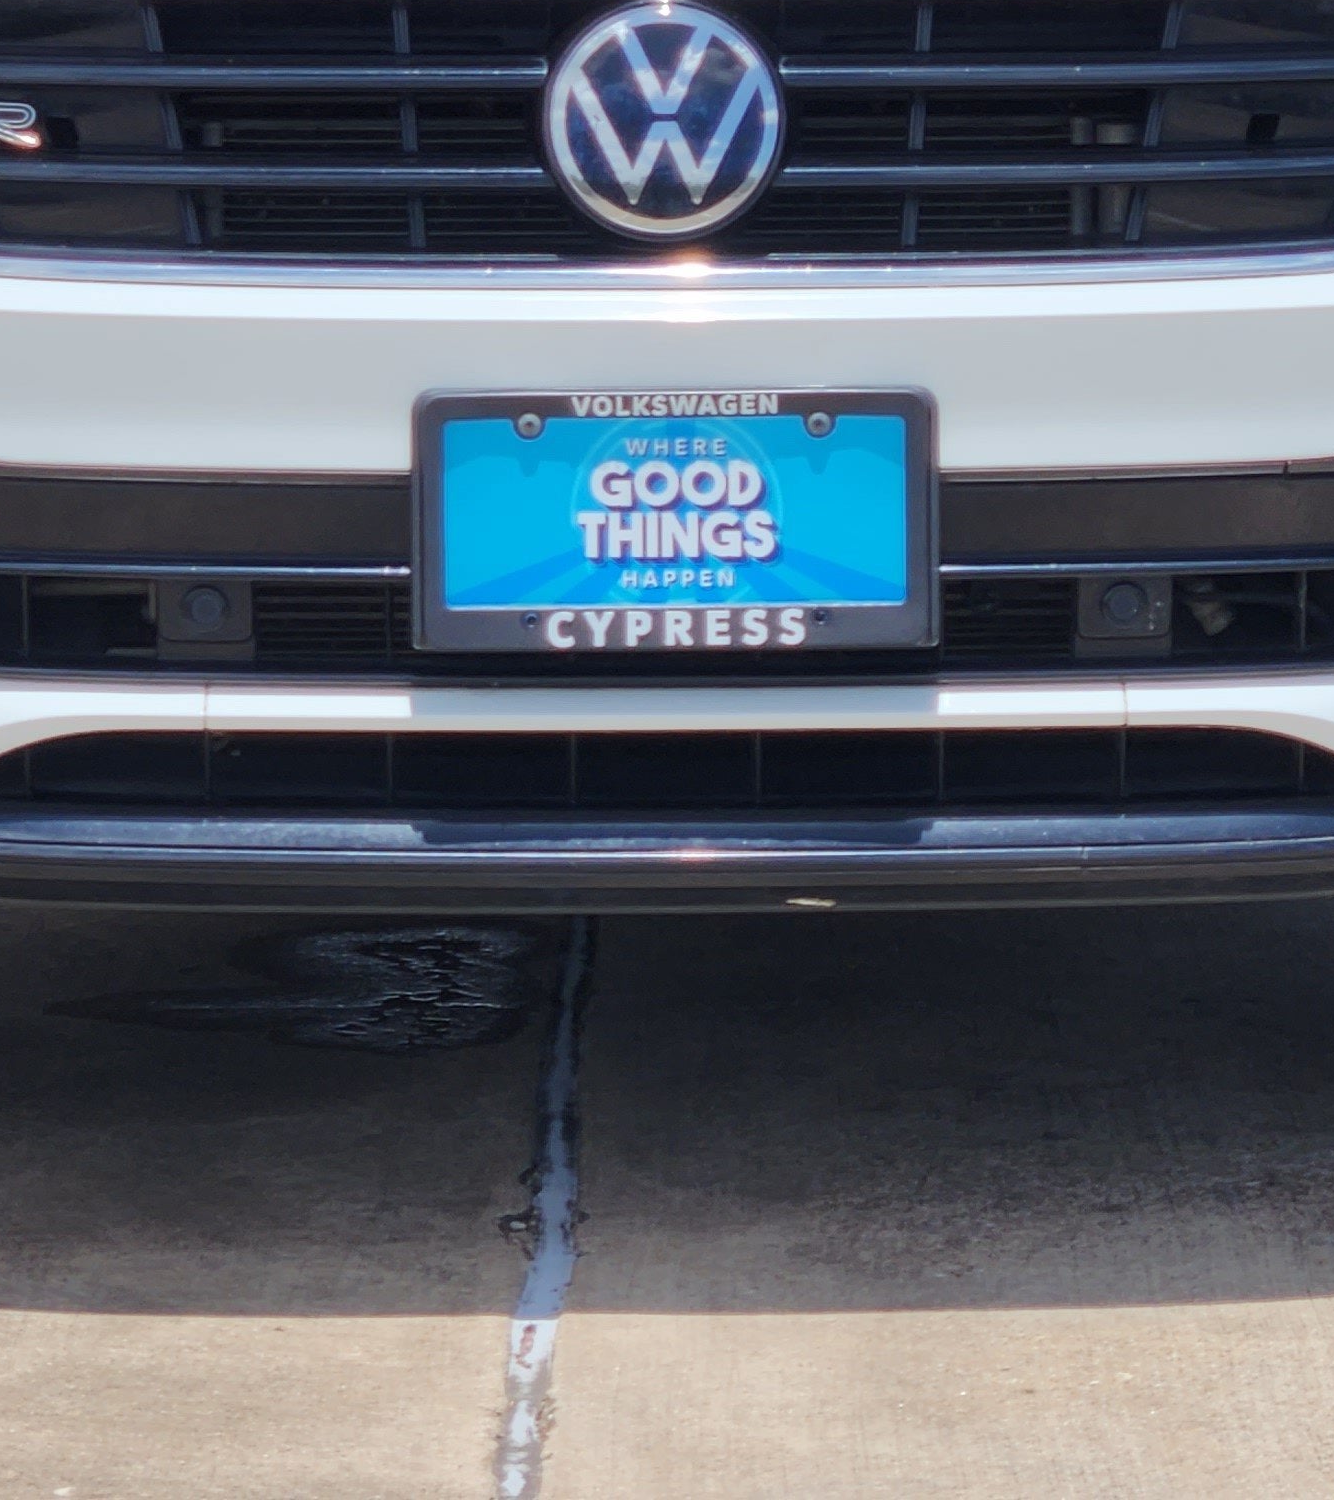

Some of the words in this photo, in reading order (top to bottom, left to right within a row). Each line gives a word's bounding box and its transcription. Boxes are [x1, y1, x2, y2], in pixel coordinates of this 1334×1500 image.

[570, 393, 780, 418] VOLKSWAGEN
[624, 437, 728, 457] WHERE
[589, 459, 765, 509] GOOD
[576, 510, 779, 562] THINGS
[620, 567, 736, 589] HAPPEN
[546, 607, 807, 649] CYPRESS
